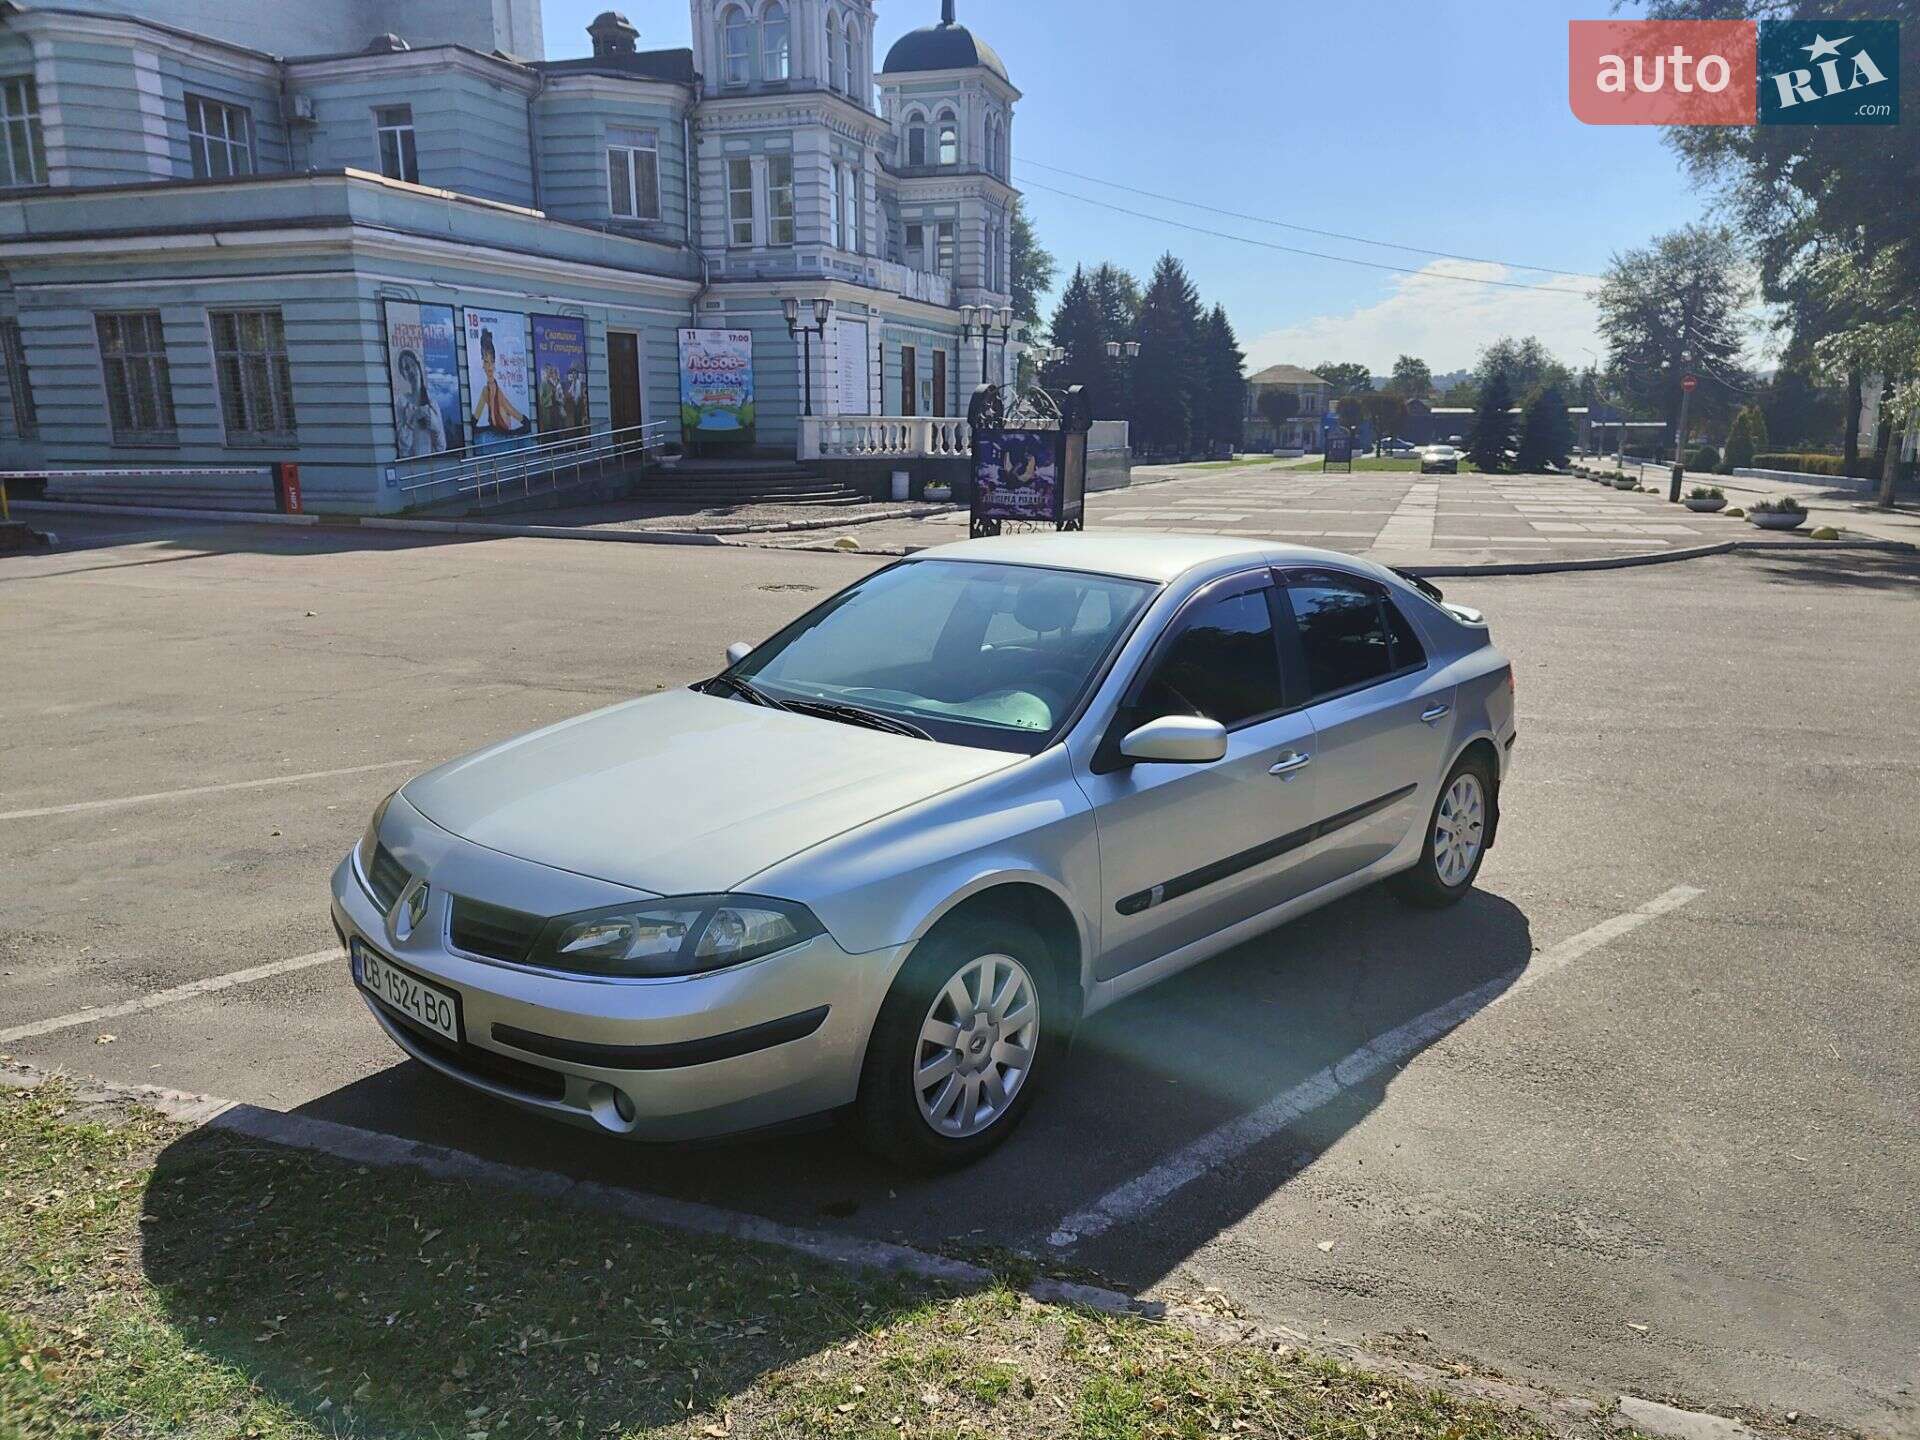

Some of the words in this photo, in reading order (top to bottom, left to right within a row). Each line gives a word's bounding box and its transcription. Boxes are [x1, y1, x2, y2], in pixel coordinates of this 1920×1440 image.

[467, 313, 479, 327] 18
[687, 331, 696, 340] 11
[729, 334, 749, 342] 17:00
[363, 953, 381, 989] CB
[384, 969, 422, 1017] 1524
[423, 990, 452, 1032] BO
